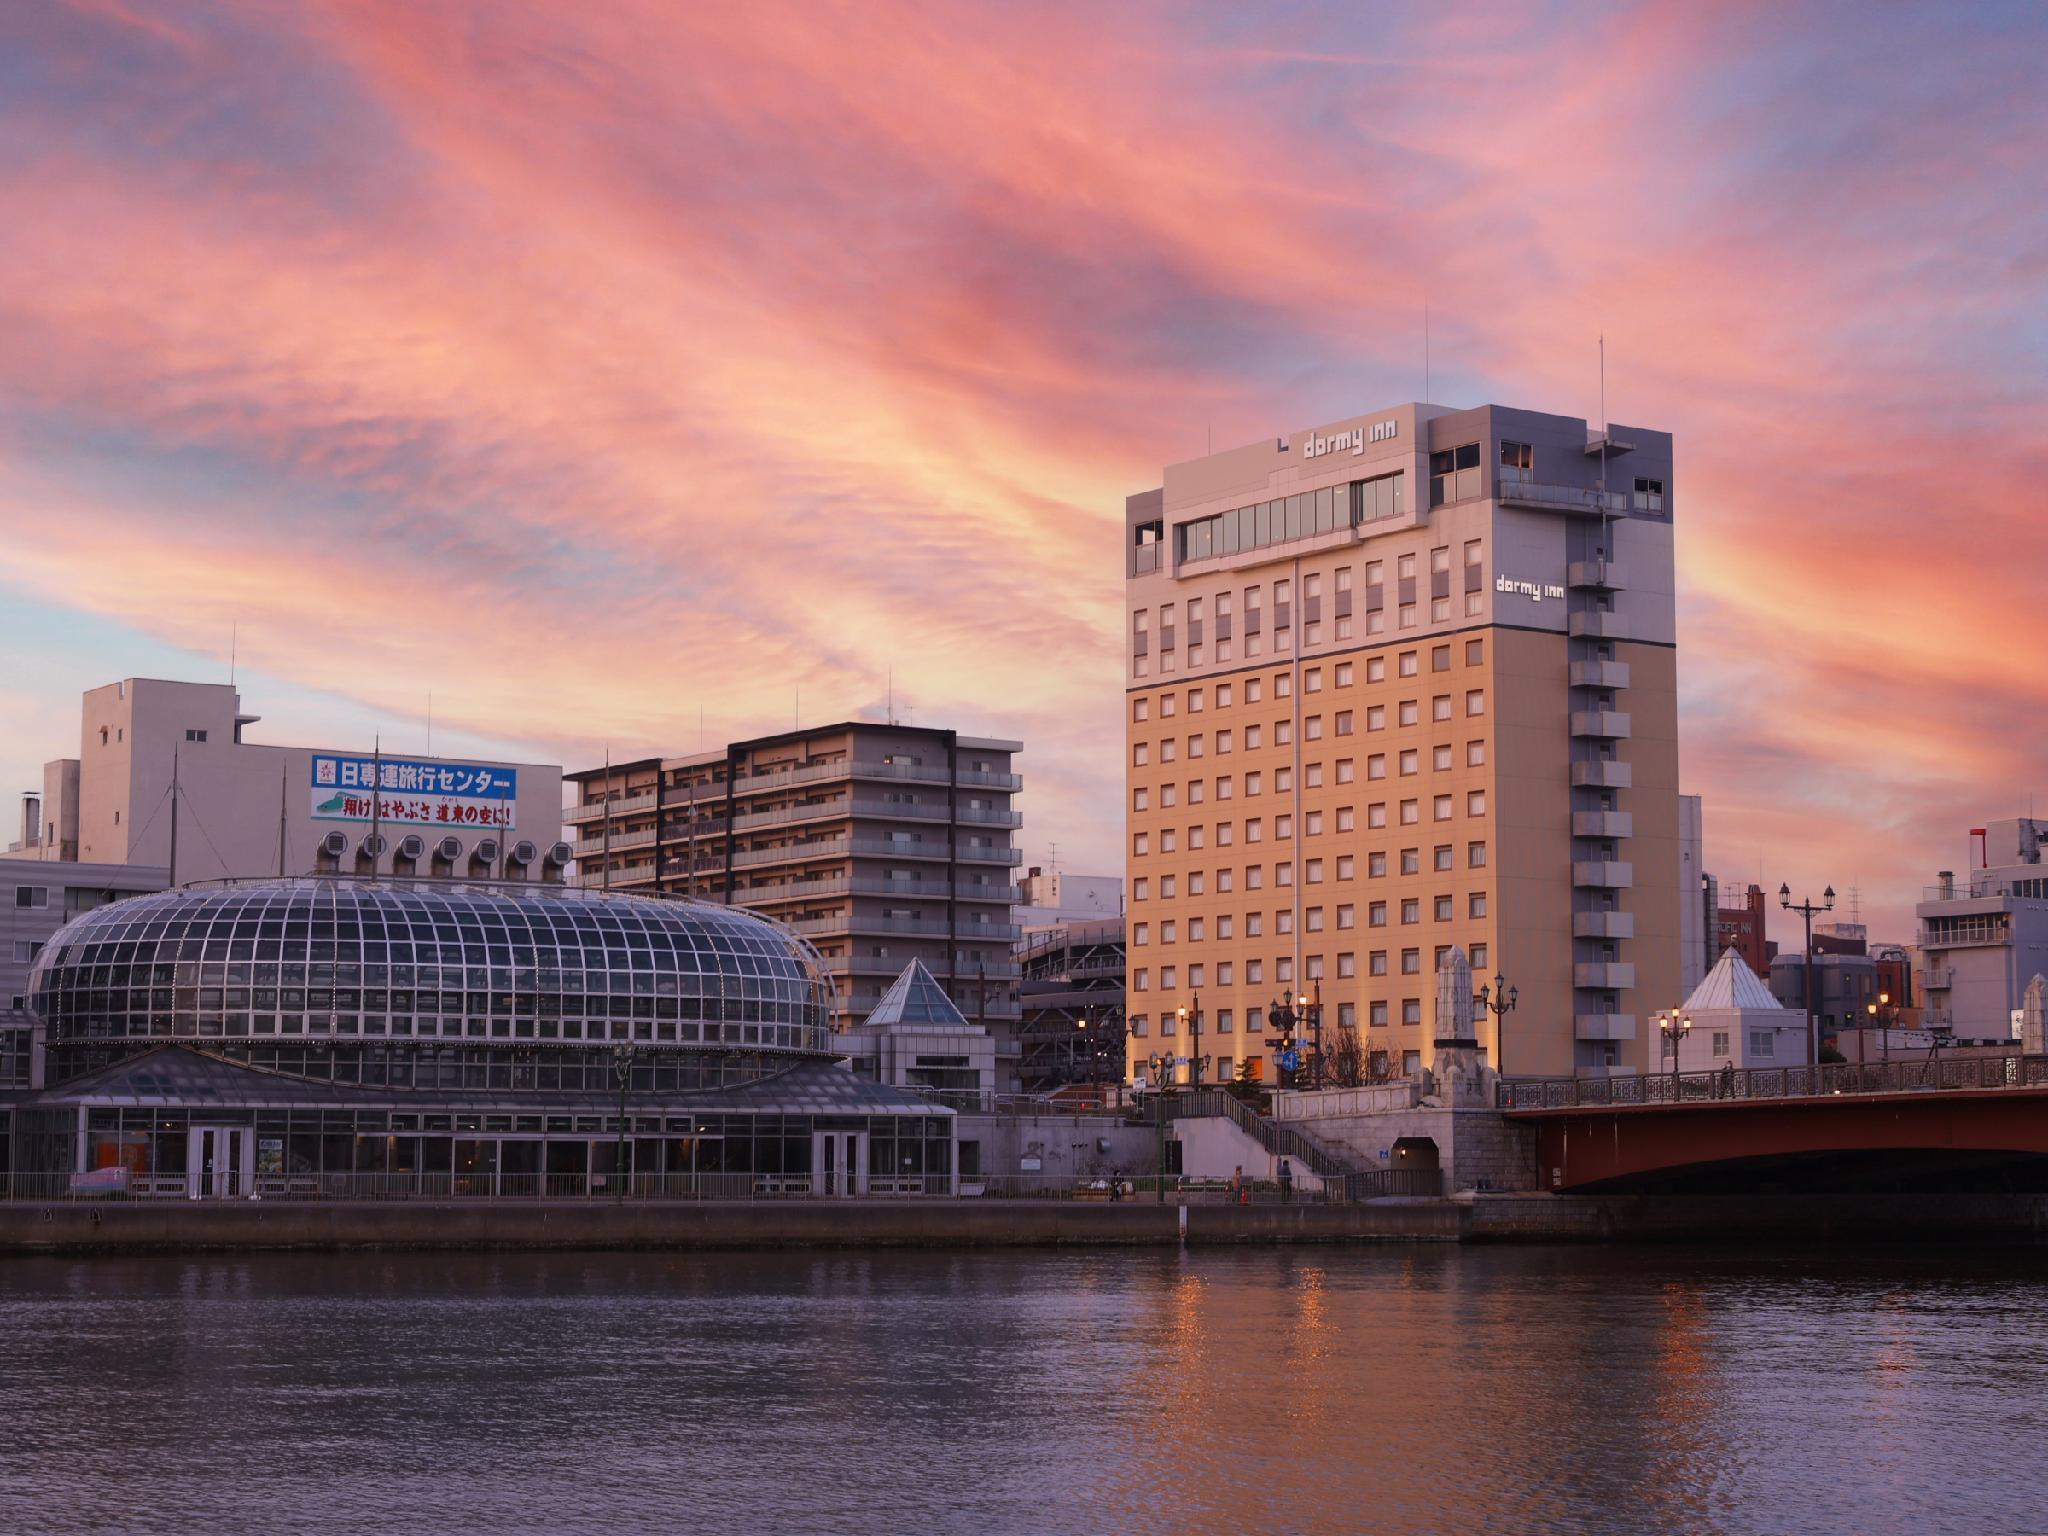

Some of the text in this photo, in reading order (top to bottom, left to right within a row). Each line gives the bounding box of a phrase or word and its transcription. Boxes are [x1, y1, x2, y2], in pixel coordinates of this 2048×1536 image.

[1303, 419, 1397, 459] dormy inn
[1496, 574, 1564, 602] dormy inn
[341, 761, 511, 793] 日専連旅行センター
